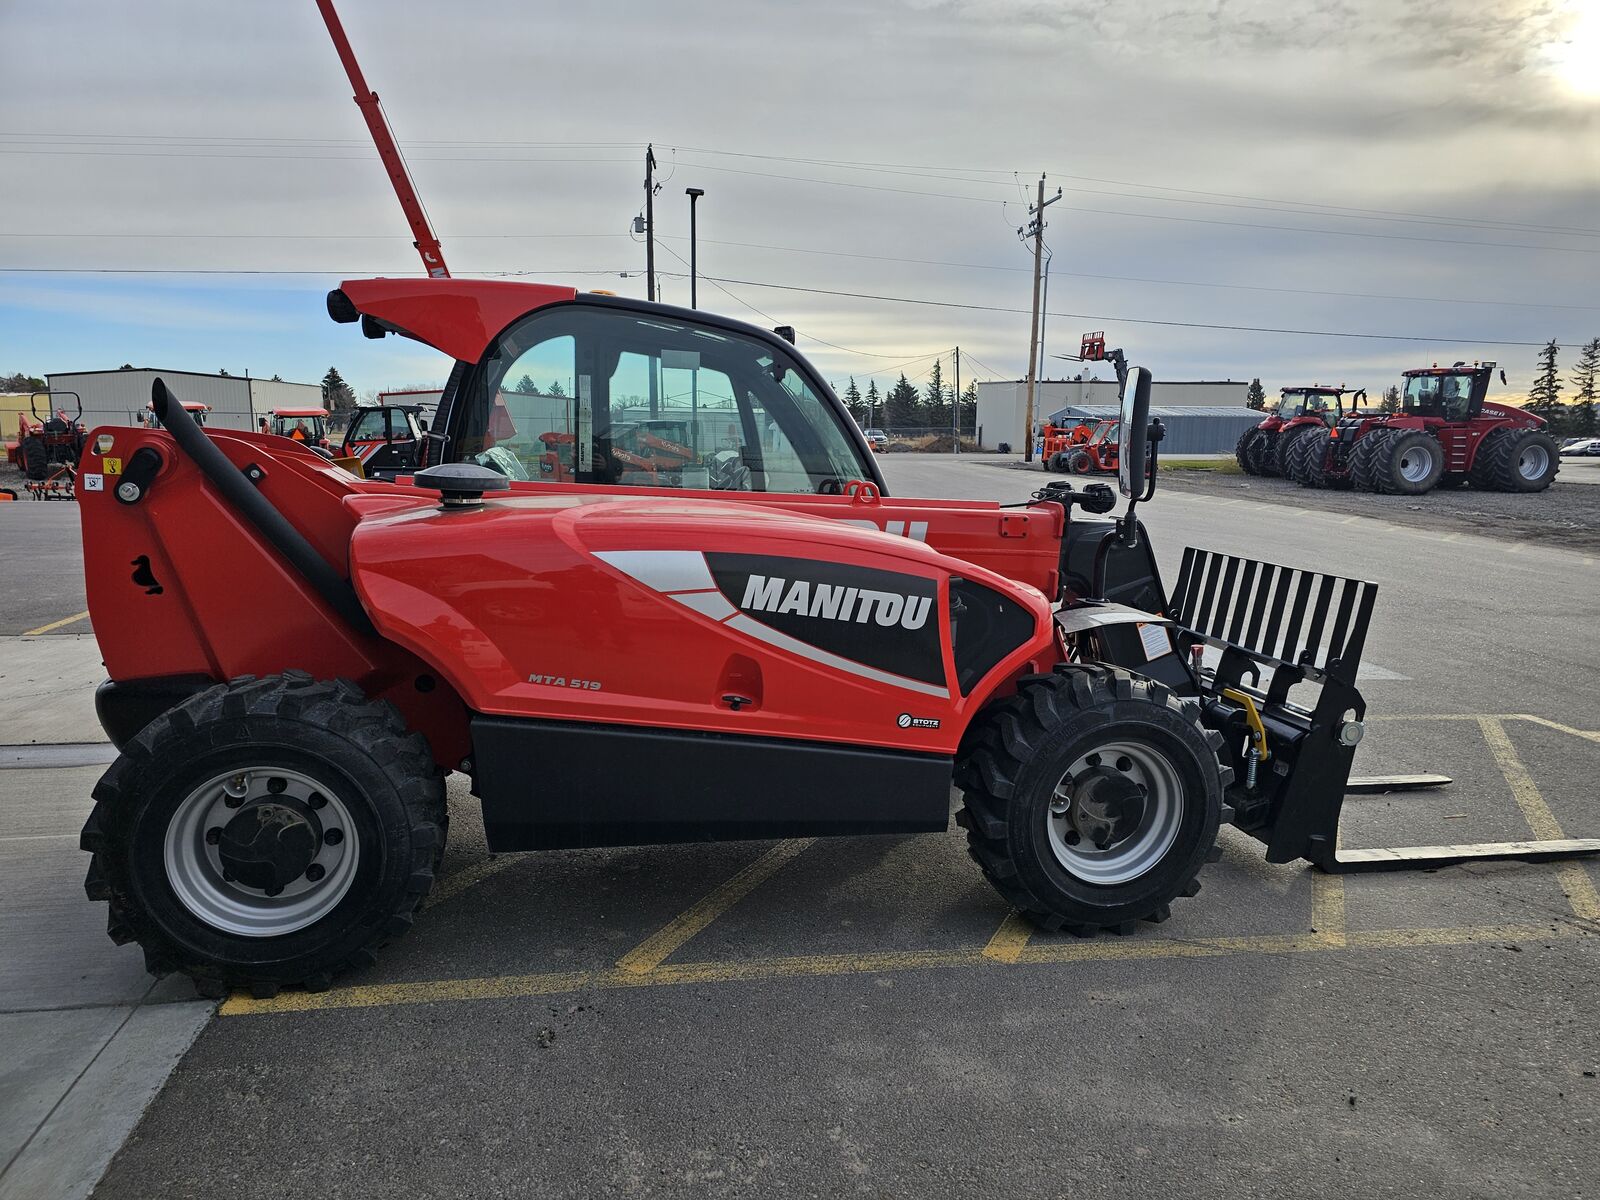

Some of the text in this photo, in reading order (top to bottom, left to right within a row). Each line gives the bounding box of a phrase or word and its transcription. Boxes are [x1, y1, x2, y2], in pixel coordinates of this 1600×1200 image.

[740, 574, 933, 630] MANITOU
[528, 673, 602, 690] MTA 519
[913, 718, 939, 726] STOTZ
